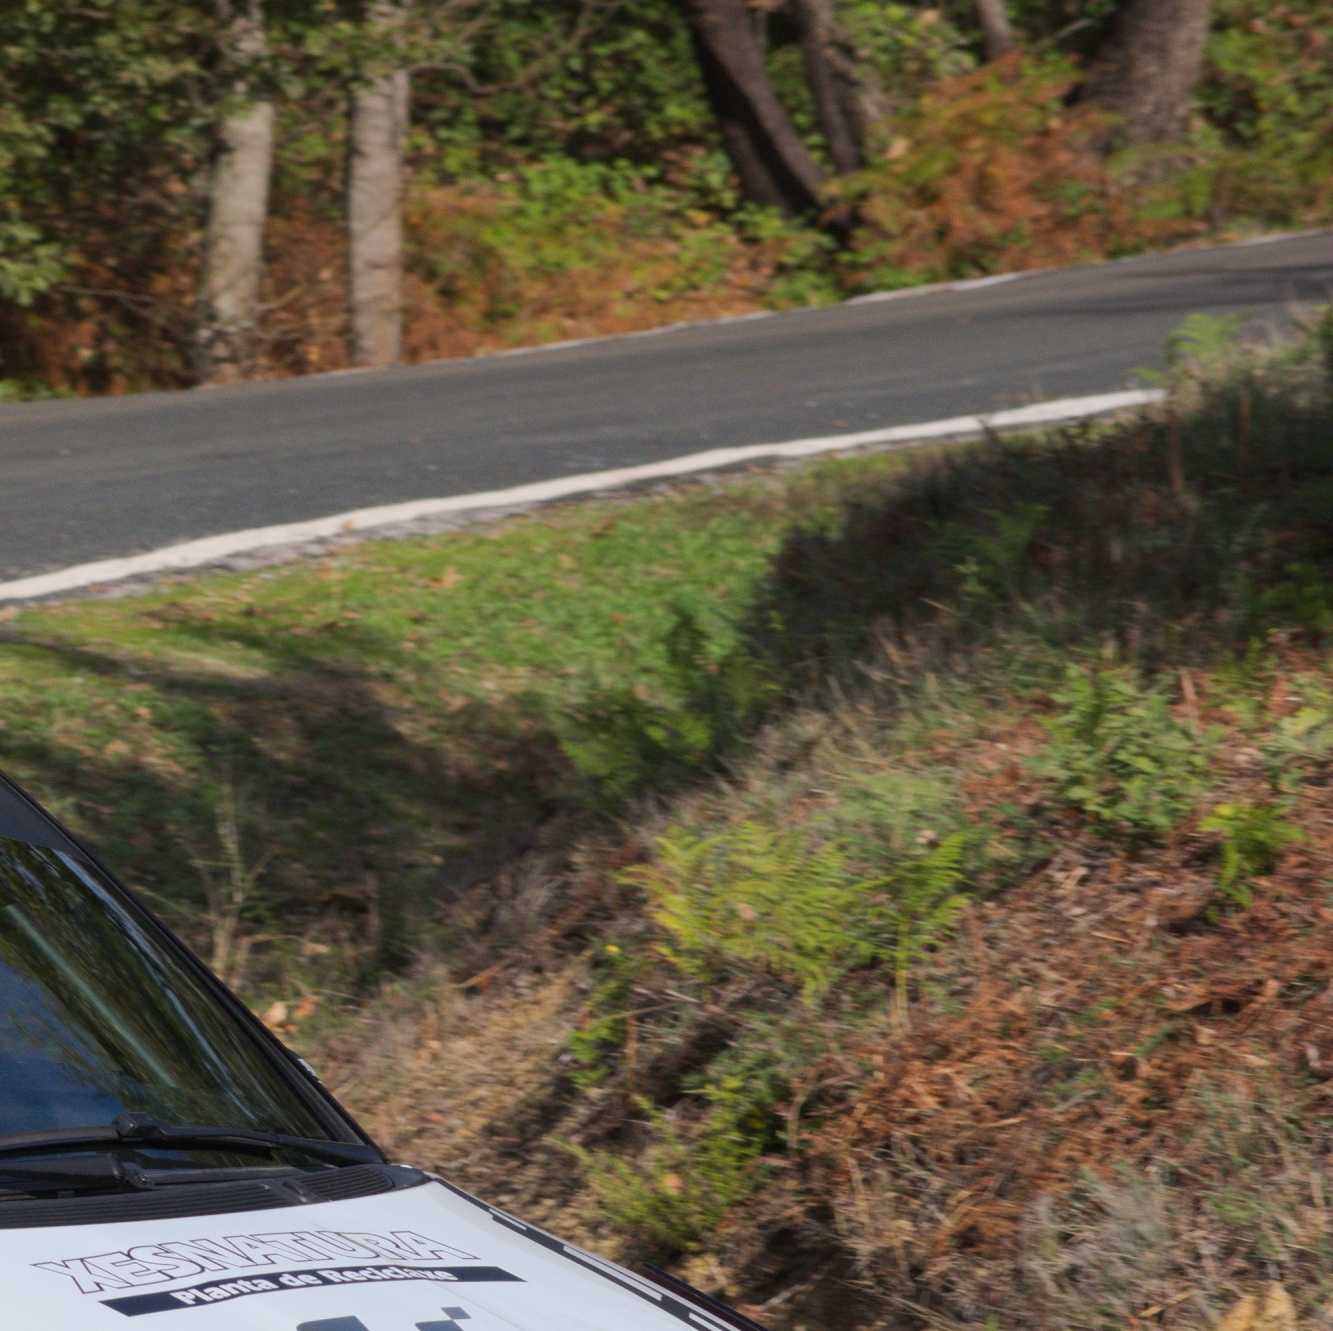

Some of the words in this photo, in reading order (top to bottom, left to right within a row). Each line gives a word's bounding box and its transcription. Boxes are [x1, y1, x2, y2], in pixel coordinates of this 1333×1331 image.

[30, 1231, 481, 1294] XESNATURA
[170, 1275, 277, 1306] Planta
[278, 1270, 324, 1289] de
[330, 1264, 459, 1285] Reciclaxe
